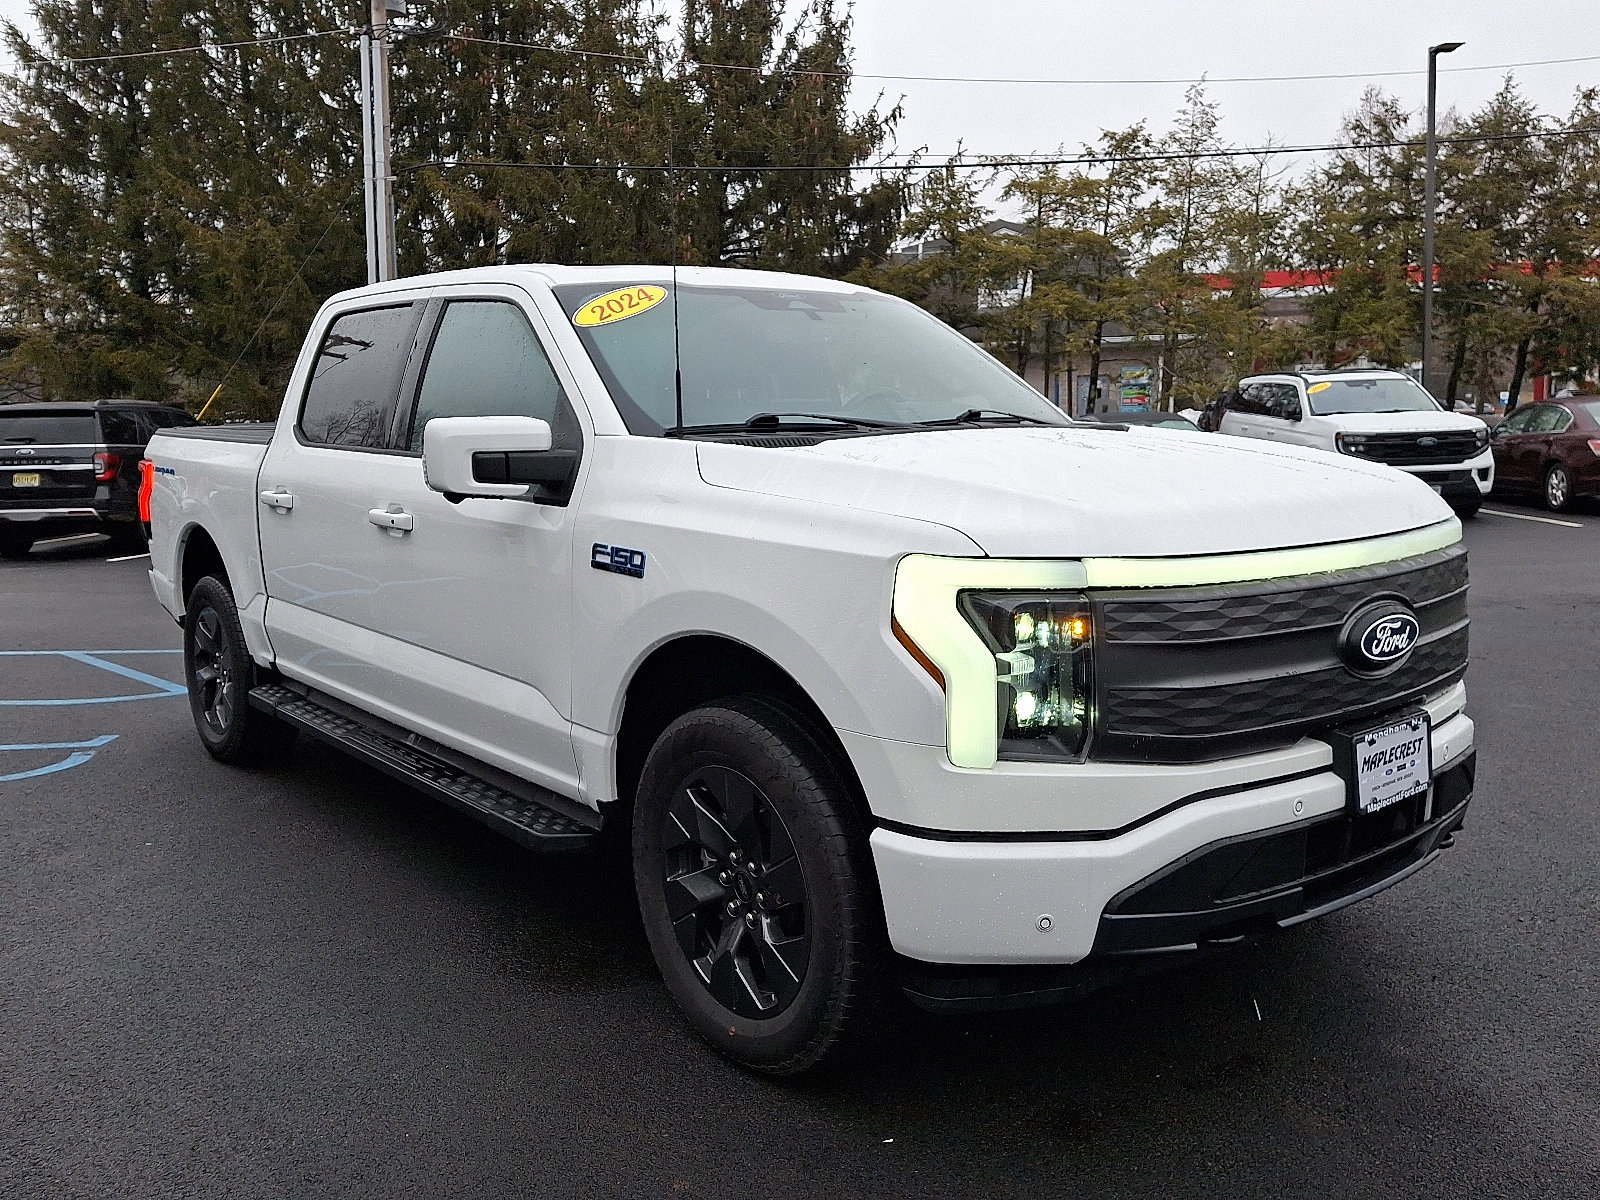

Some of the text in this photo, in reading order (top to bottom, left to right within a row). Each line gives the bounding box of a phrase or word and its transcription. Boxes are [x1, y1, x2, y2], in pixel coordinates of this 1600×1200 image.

[591, 288, 654, 321] 2024
[1372, 621, 1410, 654] Ford
[1411, 717, 1423, 727] NJ
[1361, 737, 1424, 774] MAPLECREST
